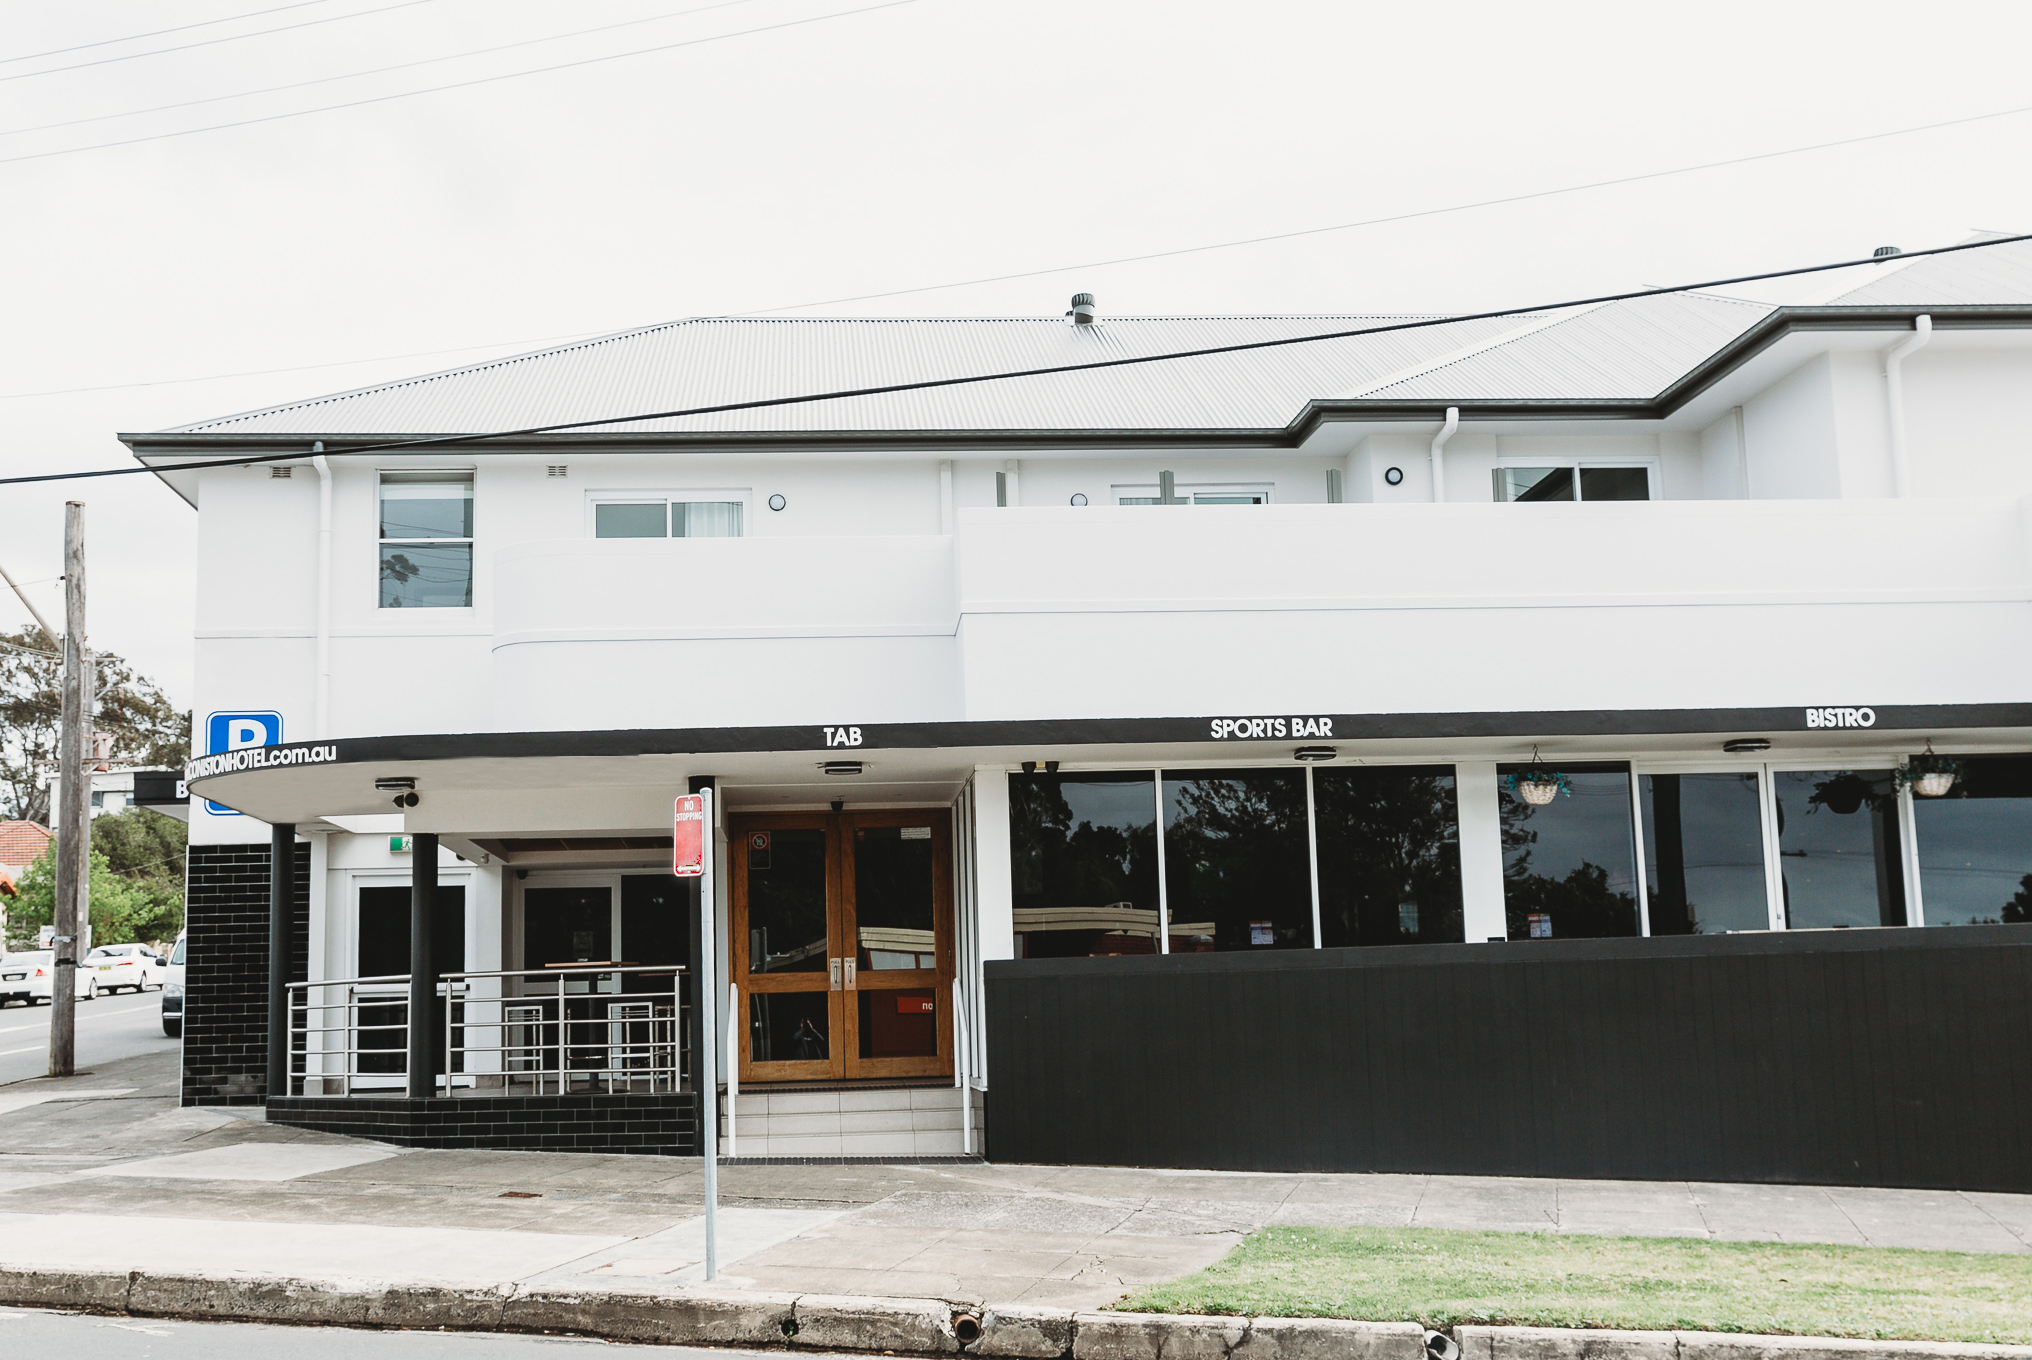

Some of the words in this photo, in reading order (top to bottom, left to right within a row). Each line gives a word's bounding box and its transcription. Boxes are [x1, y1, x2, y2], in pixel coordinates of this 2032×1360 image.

[1210, 718, 1287, 739] SPORTS
[1291, 717, 1333, 737] BAR
[1805, 707, 1876, 728] BISTRO
[823, 726, 863, 747] TAB
[185, 745, 337, 782] CONISTONHOTEL.com.au
[684, 800, 694, 811] NO
[676, 811, 702, 822] STOPPING
